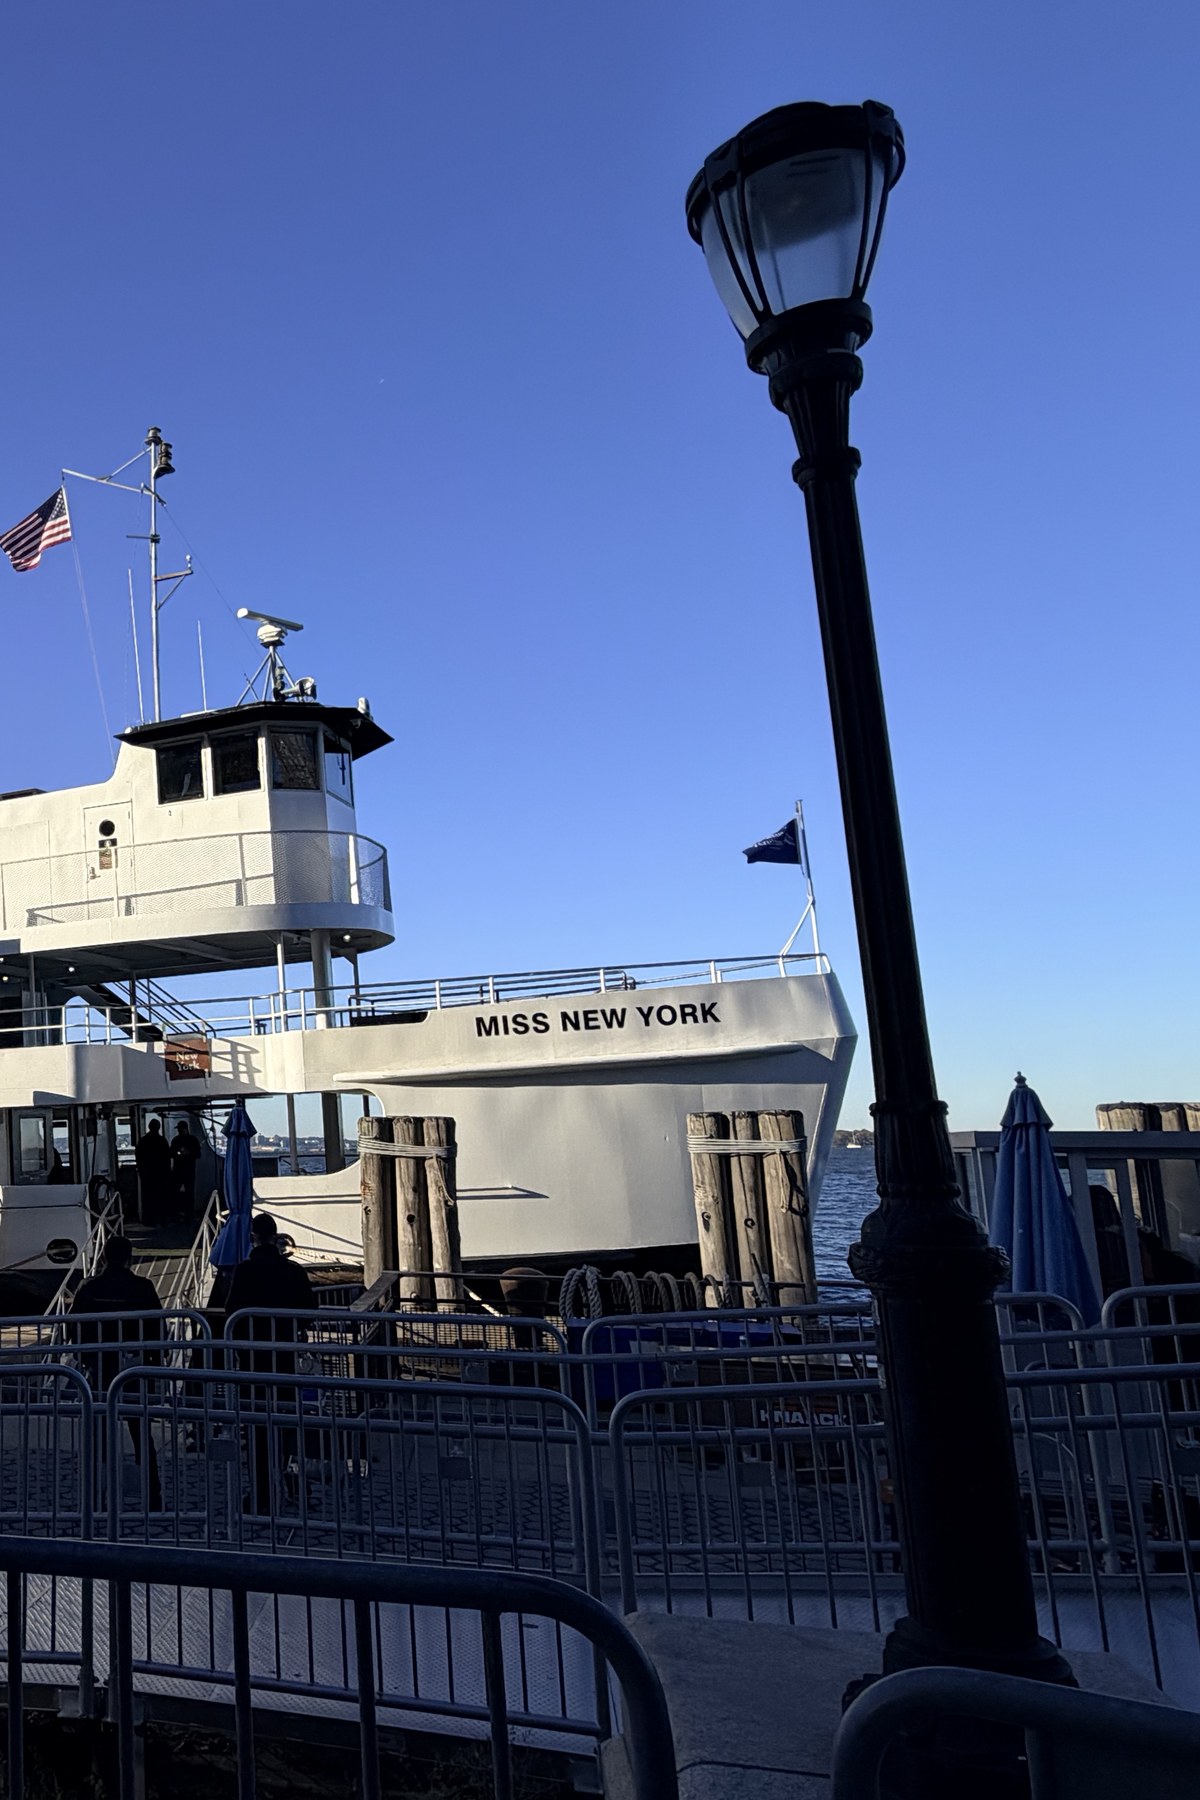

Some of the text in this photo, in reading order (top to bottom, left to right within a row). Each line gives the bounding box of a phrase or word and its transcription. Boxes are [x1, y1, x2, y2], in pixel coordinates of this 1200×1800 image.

[475, 1002, 721, 1037] MISS NEW YORK
[175, 1052, 199, 1061] New
[176, 1060, 200, 1071] York
